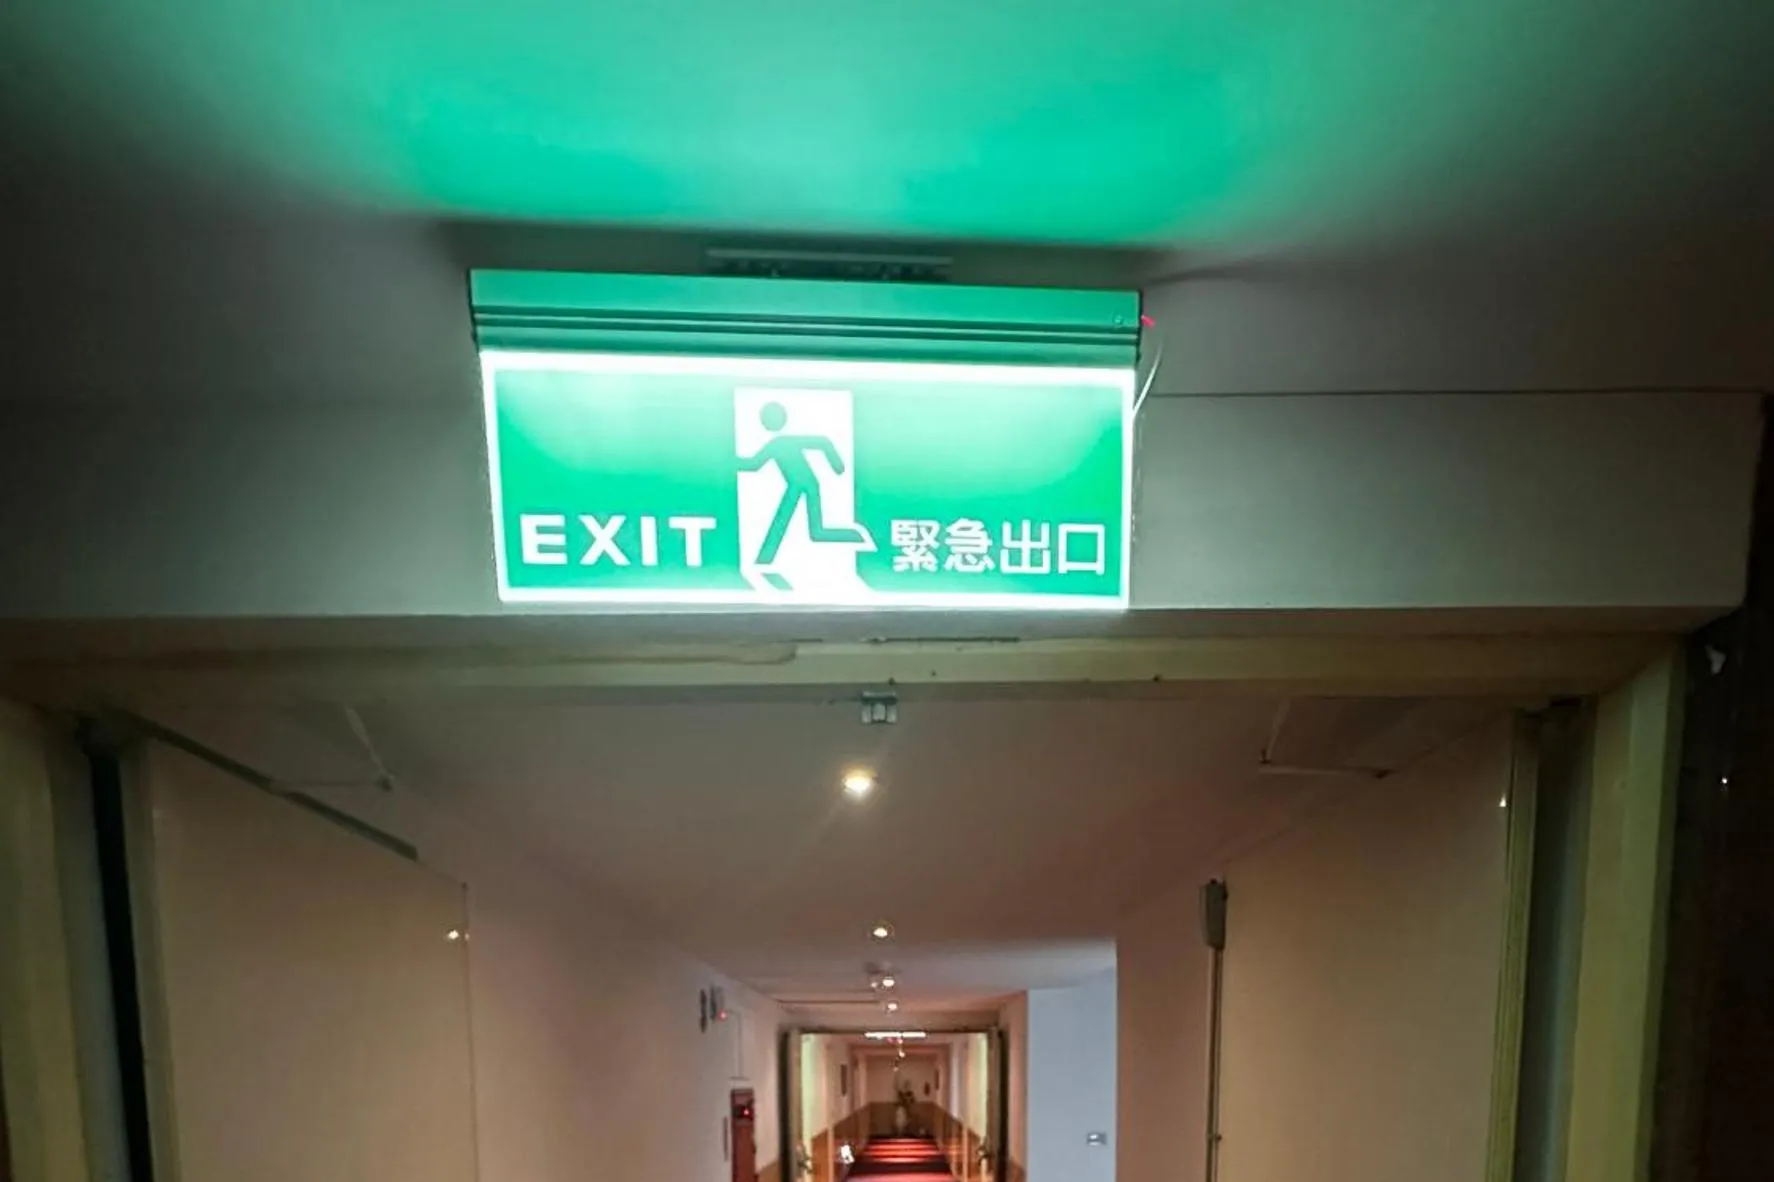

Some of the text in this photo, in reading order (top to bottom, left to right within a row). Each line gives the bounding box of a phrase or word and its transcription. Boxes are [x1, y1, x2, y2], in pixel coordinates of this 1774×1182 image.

[520, 514, 716, 567] EXIT
[890, 519, 1105, 574] 緊急出口
